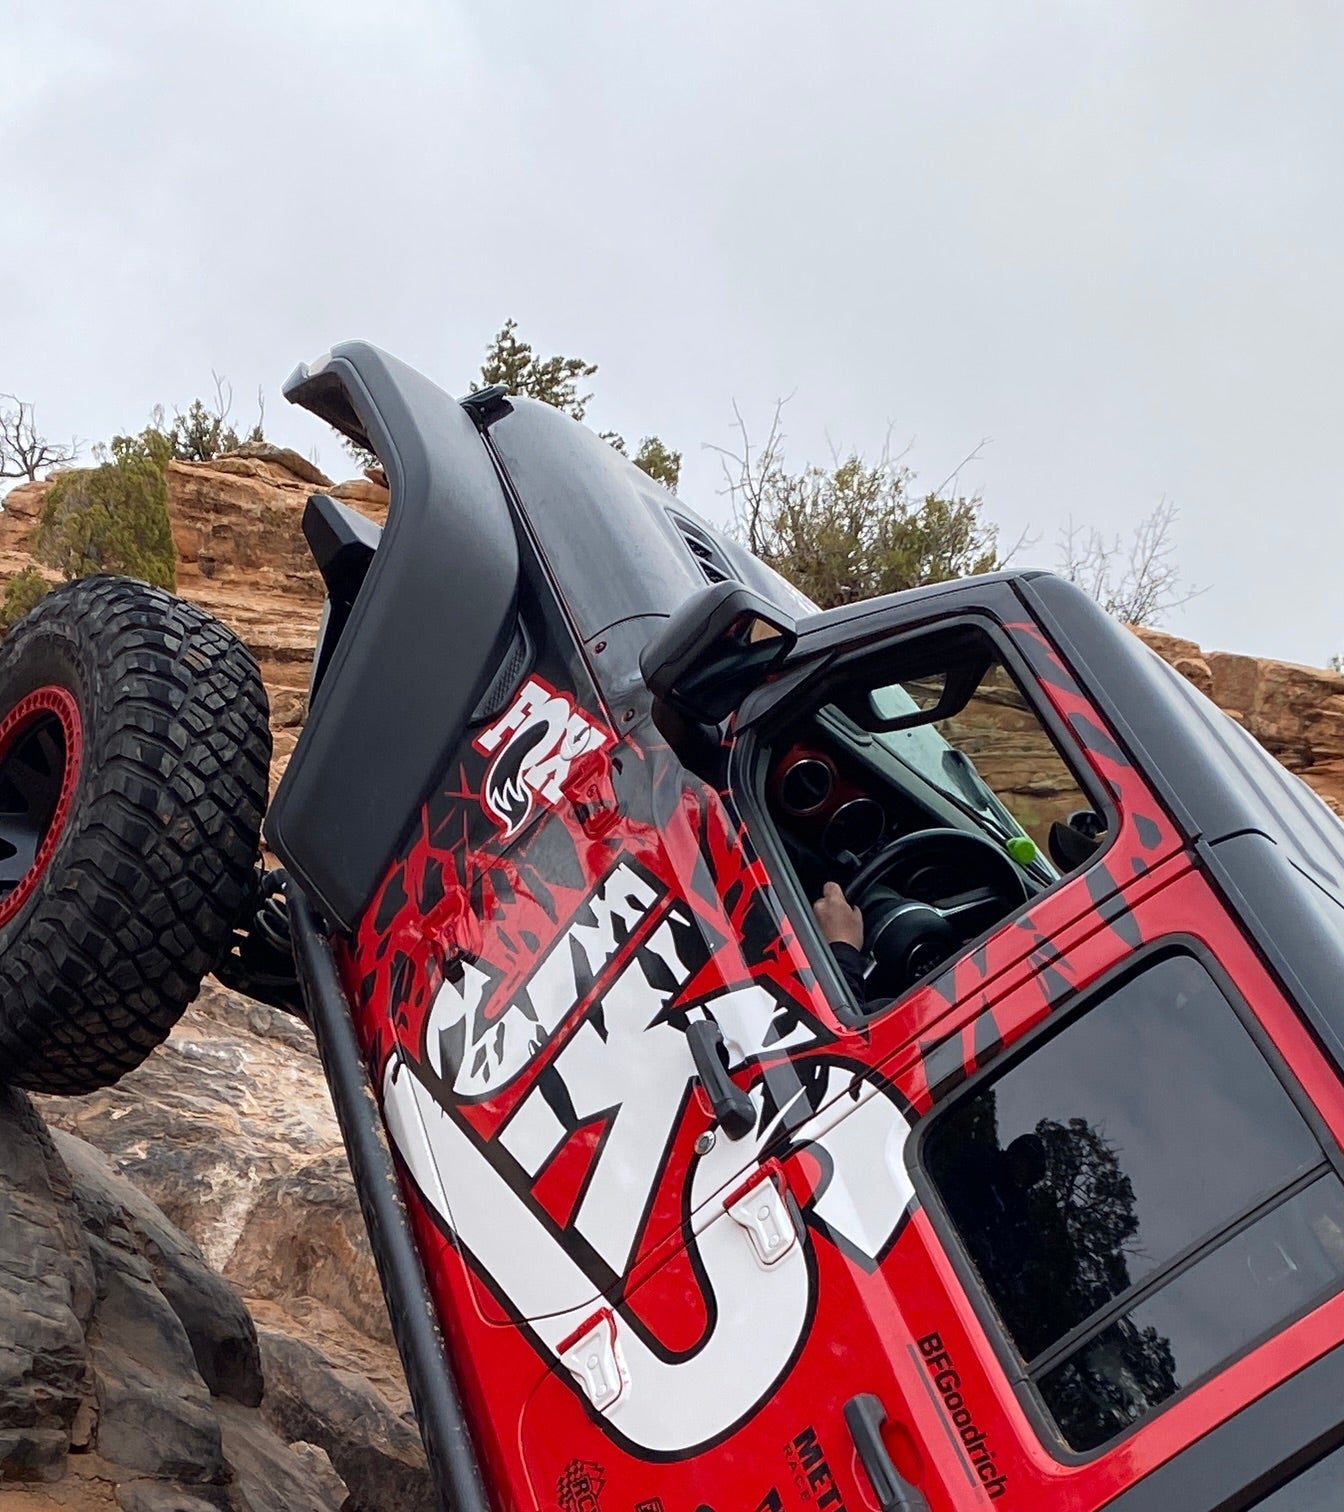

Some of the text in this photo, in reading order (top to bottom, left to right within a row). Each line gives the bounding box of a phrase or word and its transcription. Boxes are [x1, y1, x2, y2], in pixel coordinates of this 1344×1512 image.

[477, 681, 607, 838] FOX
[381, 858, 922, 1453] JKS
[784, 1444, 811, 1501] RACE
[917, 1332, 1008, 1499] BFGoodrich
